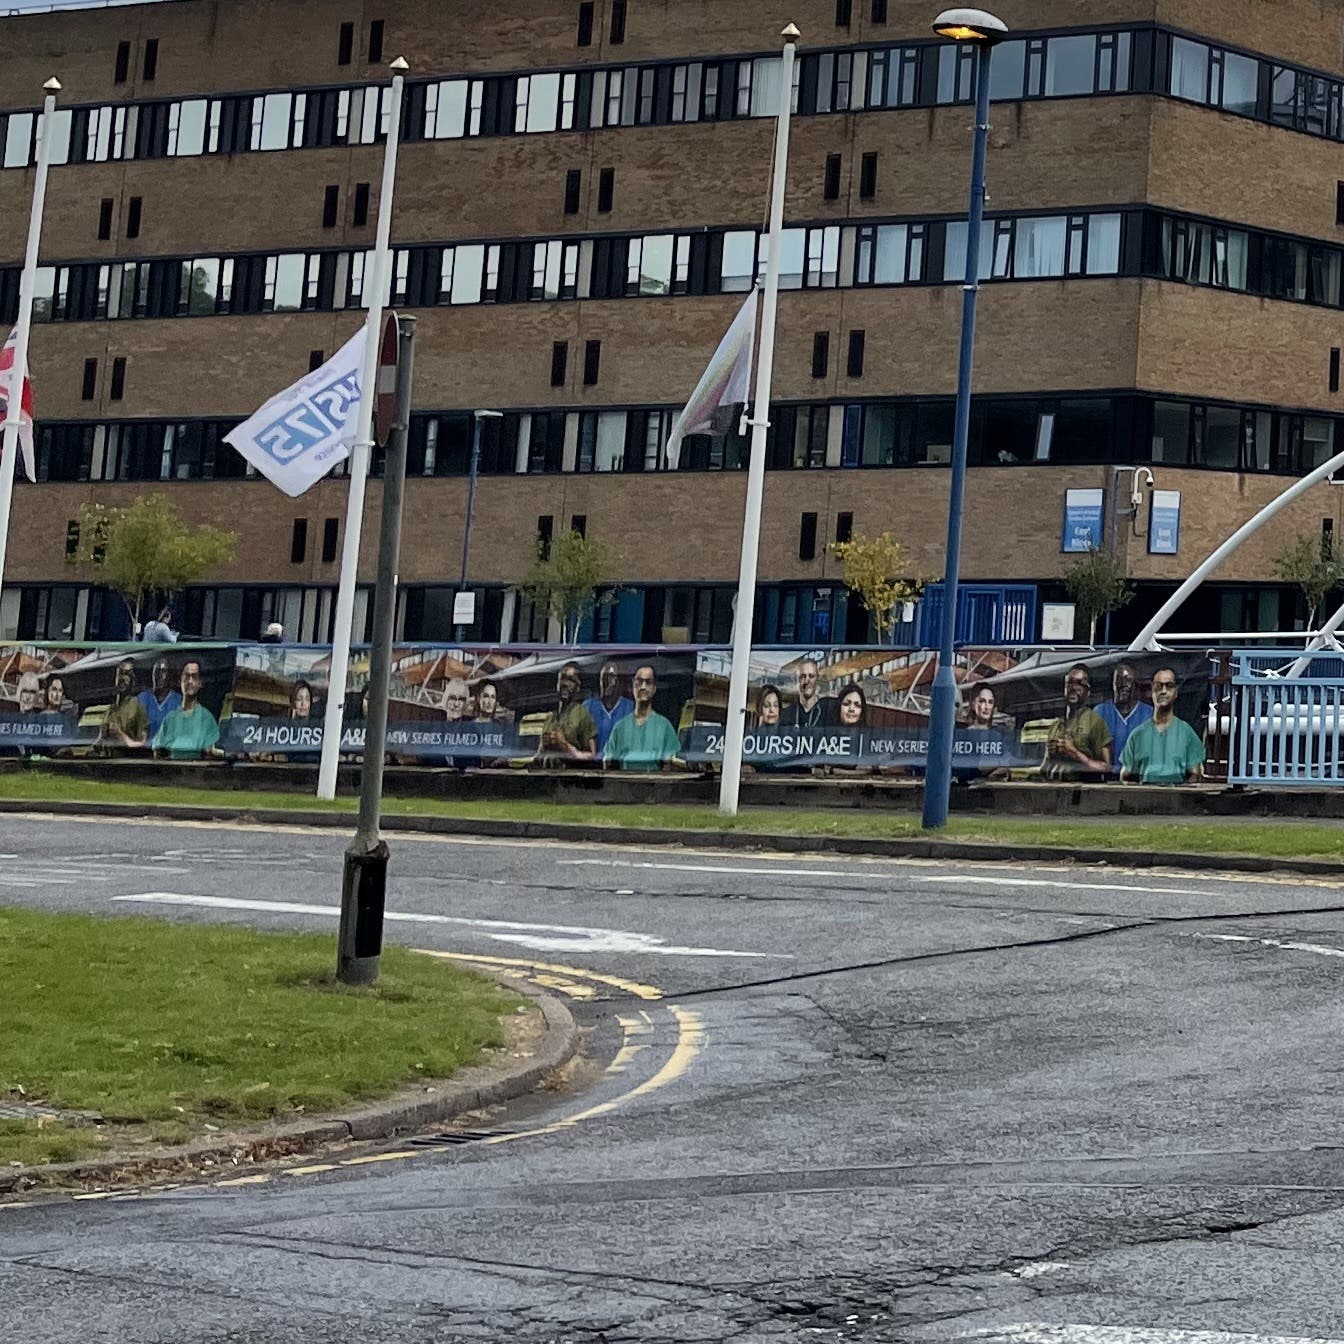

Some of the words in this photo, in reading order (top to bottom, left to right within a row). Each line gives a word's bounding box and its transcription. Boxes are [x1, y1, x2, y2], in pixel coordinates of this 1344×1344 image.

[243, 725, 262, 745] 24
[265, 726, 323, 746] HOURS
[411, 731, 442, 745] SERIES
[443, 732, 478, 746] FILMED
[480, 733, 503, 747] HERE
[743, 735, 793, 755] OURS
[796, 735, 814, 755] IN
[816, 736, 851, 756] A&E
[870, 740, 895, 753] NEW
[976, 741, 1003, 755] HERE
